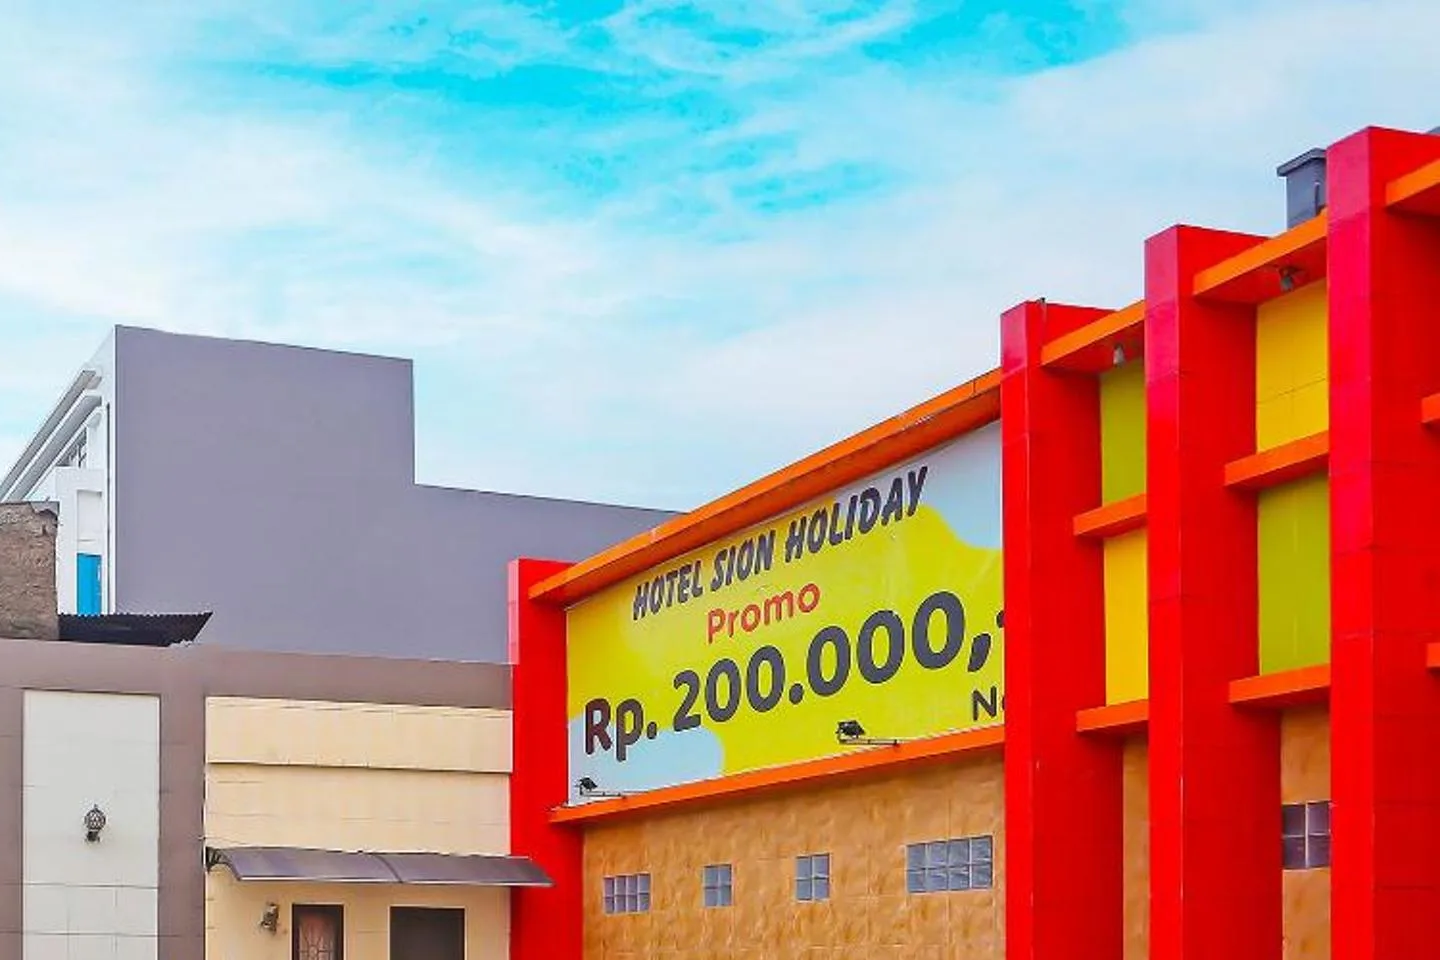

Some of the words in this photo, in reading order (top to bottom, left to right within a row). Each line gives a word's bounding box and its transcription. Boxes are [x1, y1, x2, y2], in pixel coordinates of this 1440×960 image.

[633, 560, 703, 621] HOTEL
[710, 530, 776, 593] SION
[785, 466, 928, 563] HOLIDAY
[707, 583, 821, 644] Promo
[585, 698, 658, 762] Rp.
[972, 685, 1005, 721] N
